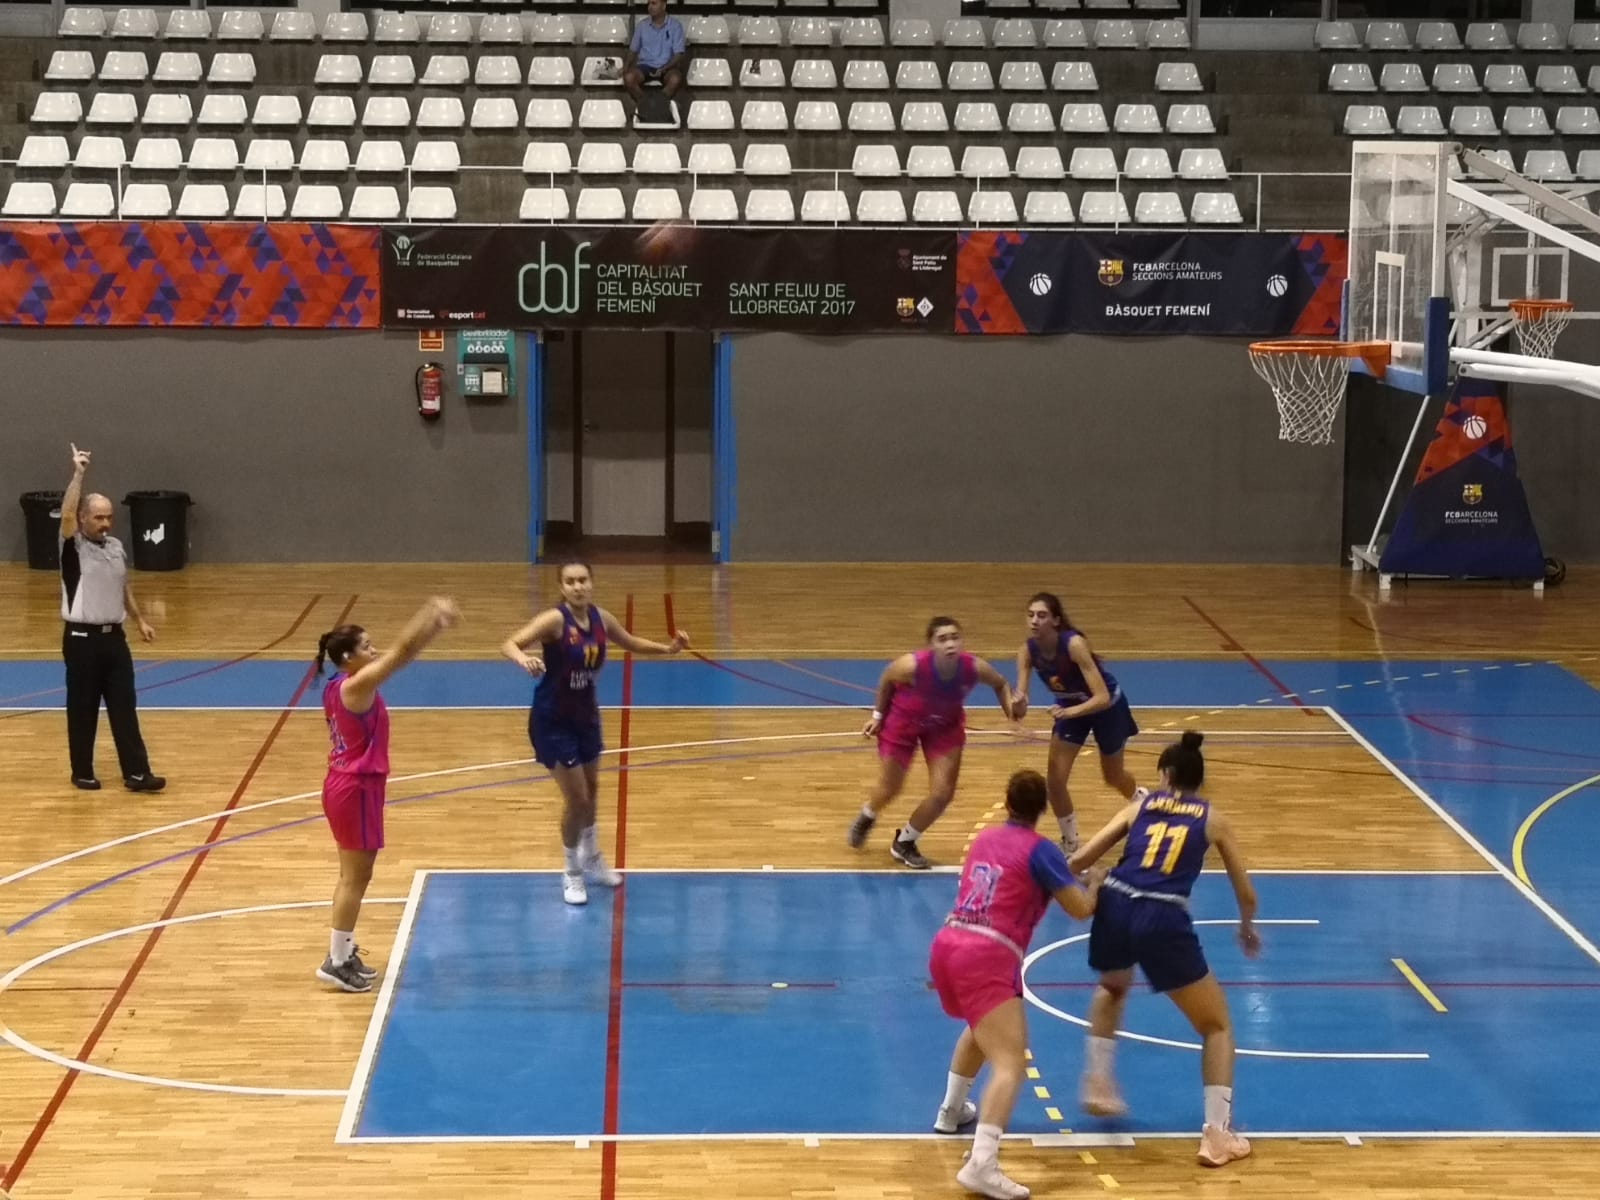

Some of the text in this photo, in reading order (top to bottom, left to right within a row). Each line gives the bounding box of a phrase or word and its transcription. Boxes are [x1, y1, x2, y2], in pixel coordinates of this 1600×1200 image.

[597, 264, 688, 279] CAPITALITAT
[1133, 262, 1201, 272] FCBARCELONA
[1132, 271, 1223, 281] SECCIONS AMATEURS
[597, 278, 702, 297] DEL BÀSQUET
[729, 282, 846, 298] SANT FELIU DE
[597, 296, 656, 313] FEMENÍ
[729, 300, 856, 315] LLOBREGAT 2017
[1105, 303, 1211, 316] BÀSQUET FEMENÍ
[1141, 820, 1190, 875] 11
